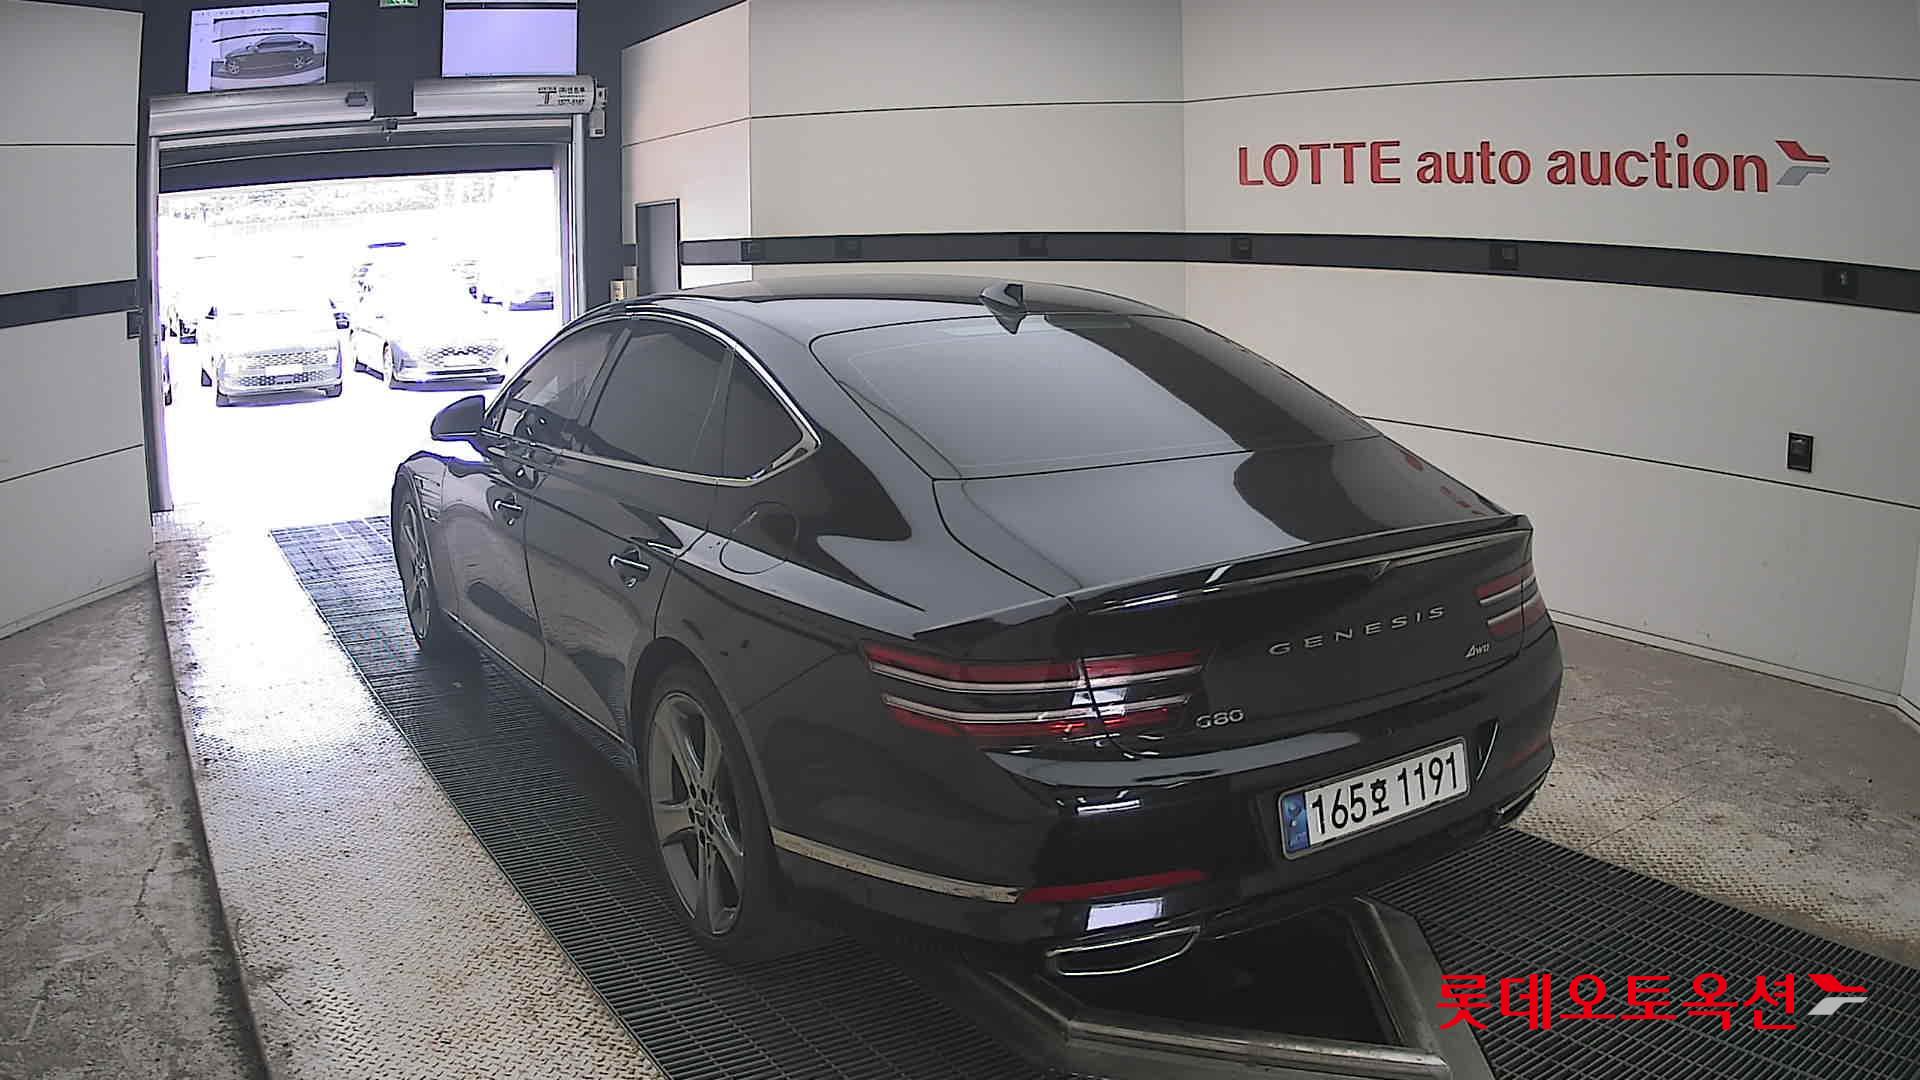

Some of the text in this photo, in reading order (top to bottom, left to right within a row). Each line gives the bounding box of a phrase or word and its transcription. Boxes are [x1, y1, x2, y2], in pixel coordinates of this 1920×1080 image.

[1239, 133, 1769, 193] LOTTE auto auction
[1268, 606, 1446, 656] GENESIS
[1195, 709, 1244, 728] G80
[1311, 751, 1457, 834] 165호 1191
